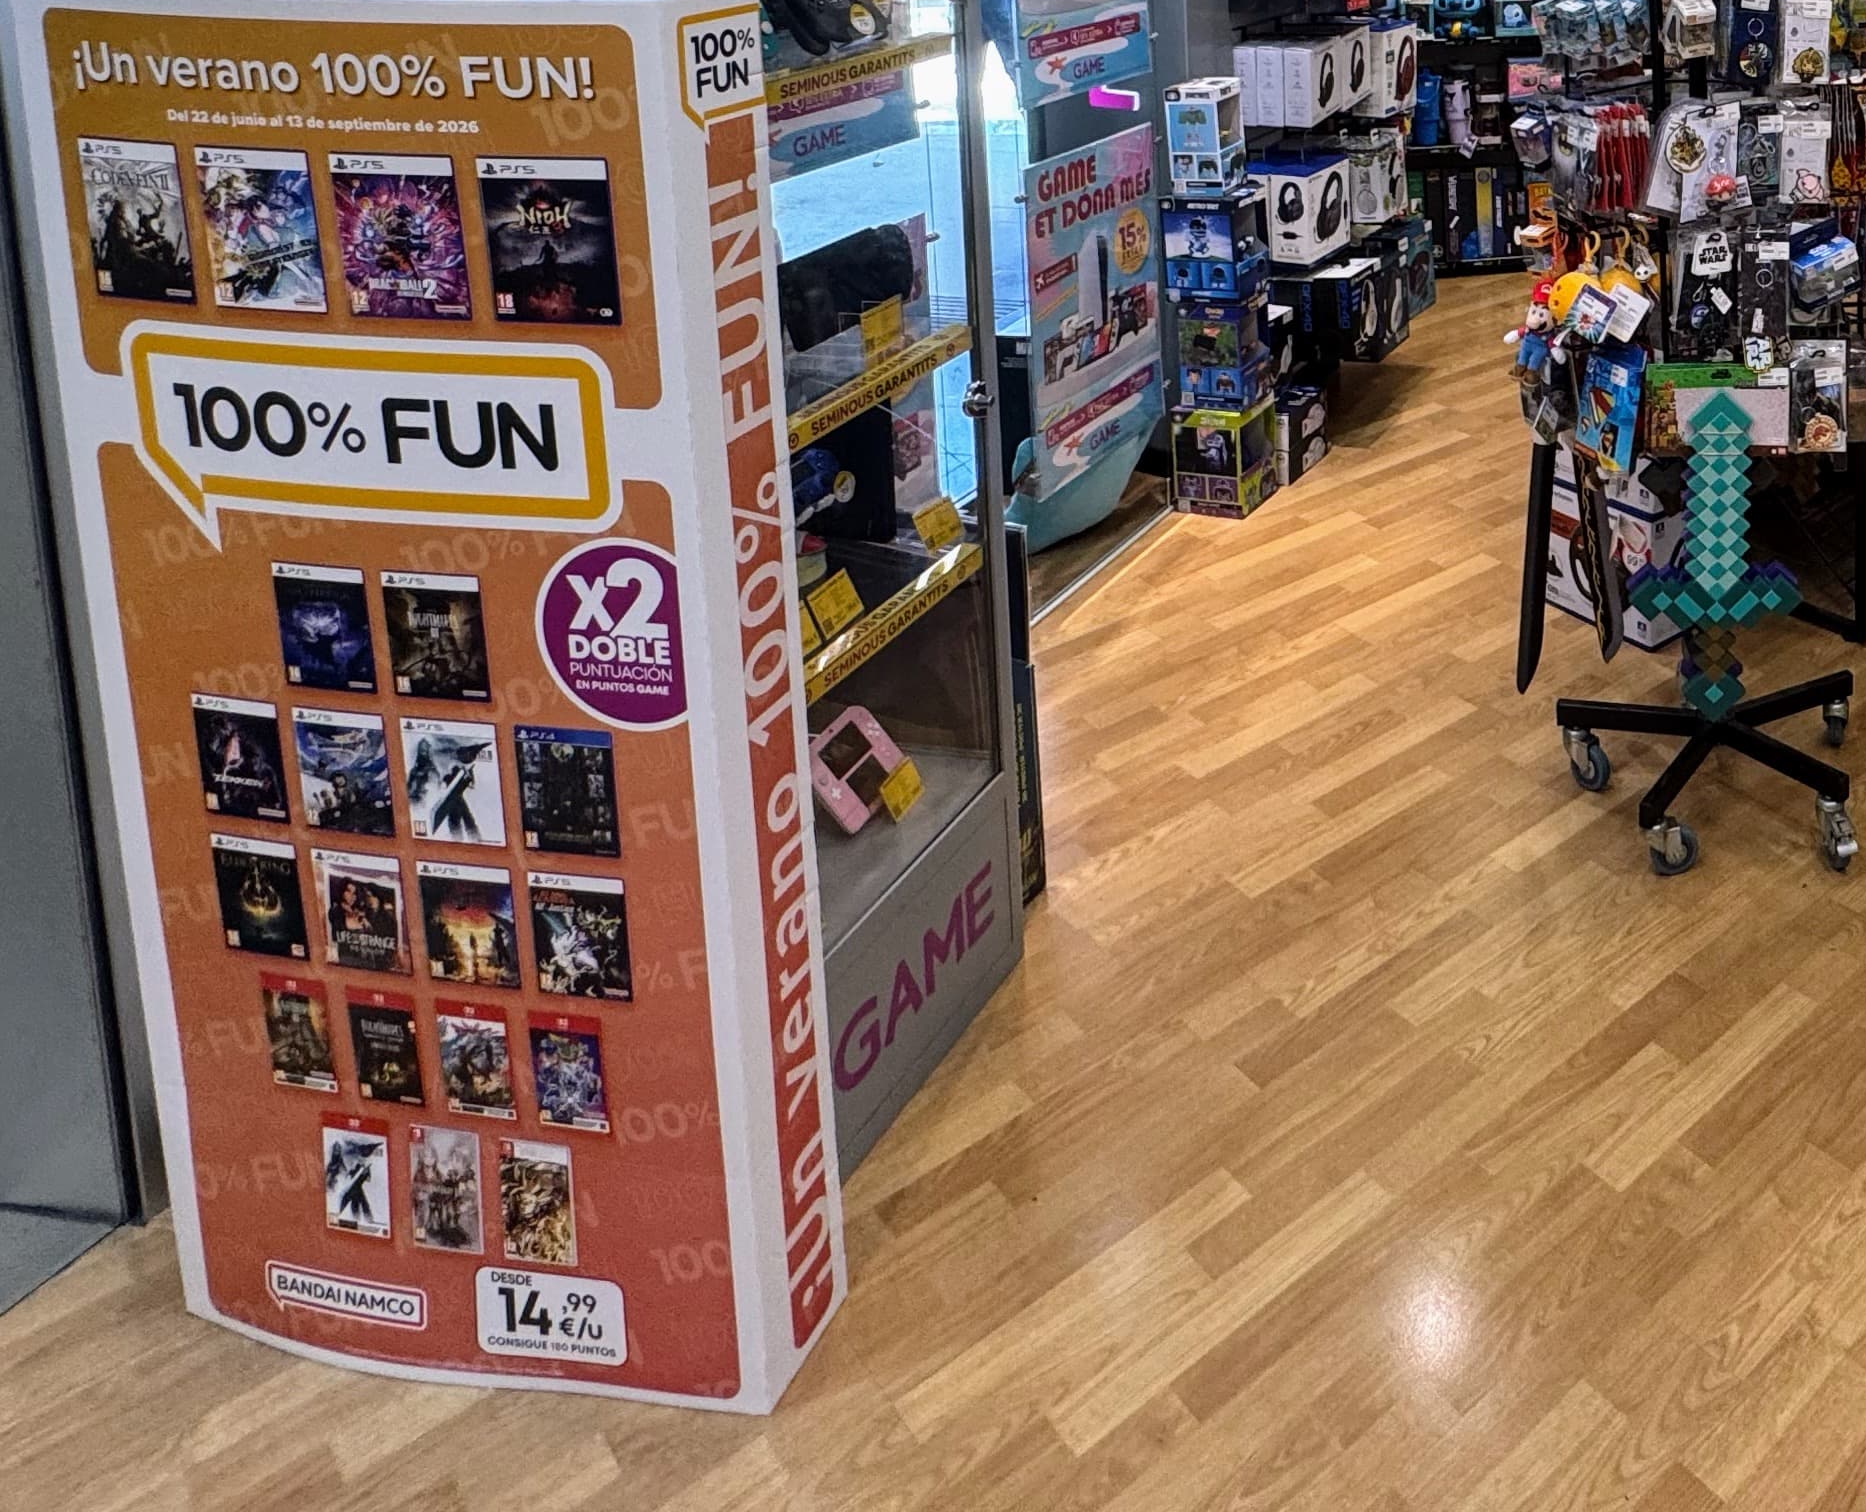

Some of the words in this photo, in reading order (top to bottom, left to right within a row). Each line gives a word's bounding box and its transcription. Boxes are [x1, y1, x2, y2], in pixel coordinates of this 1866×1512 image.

[690, 27, 755, 65] 100%
[73, 40, 138, 90] ¡Un
[147, 53, 299, 94] verano
[312, 51, 446, 98] 100%
[459, 56, 595, 100] FUN!
[697, 58, 749, 98] FUN
[780, 68, 847, 99] SEMINOUS
[849, 49, 915, 79] GARANTITS
[1073, 56, 1105, 77] GAME
[167, 108, 188, 123] Del
[191, 110, 208, 124] 22
[212, 111, 228, 125] de
[231, 112, 266, 129] junio
[270, 114, 283, 128] al
[286, 115, 303, 128] 13
[307, 115, 324, 129] de
[328, 116, 411, 136] septiembre
[415, 119, 434, 133] de
[436, 120, 478, 135] 2026
[95, 144, 122, 155] PS5
[793, 124, 846, 157] GAME
[213, 153, 243, 164] PS5
[350, 158, 384, 170] PS5
[499, 164, 536, 175] PS5
[1038, 155, 1096, 201] GAME
[1035, 206, 1057, 238] ET
[1120, 165, 1150, 203] MÉS
[1119, 222, 1147, 251] 15%
[1700, 246, 1728, 258] STAR
[1699, 254, 1728, 266] WARS
[497, 293, 514, 309] 18
[708, 176, 772, 445] FUN!
[811, 392, 874, 436] SEMINOUS
[875, 354, 938, 399] GARANTITS
[174, 384, 366, 457] 100%
[381, 397, 559, 473] FUN
[1090, 418, 1120, 451] GAME
[565, 557, 669, 639] x2
[731, 471, 793, 746] 100%
[568, 634, 672, 665] DOBLE
[824, 629, 886, 687] SEMINOUS
[888, 581, 949, 633] GARANTITS
[569, 662, 673, 683] PUNTUACIÓN
[576, 679, 590, 690] EN
[591, 681, 635, 694] PUNTOS
[636, 683, 670, 696] GAME
[527, 729, 557, 740] PS4
[767, 772, 818, 1120] verano
[834, 859, 994, 1092] GAME
[277, 1274, 342, 1304] BANDAI
[344, 1291, 415, 1317] NAMCO
[490, 1271, 533, 1287] DESDE
[488, 1335, 547, 1351] CONSIGUE
[571, 1343, 616, 1358] PUNTOS
